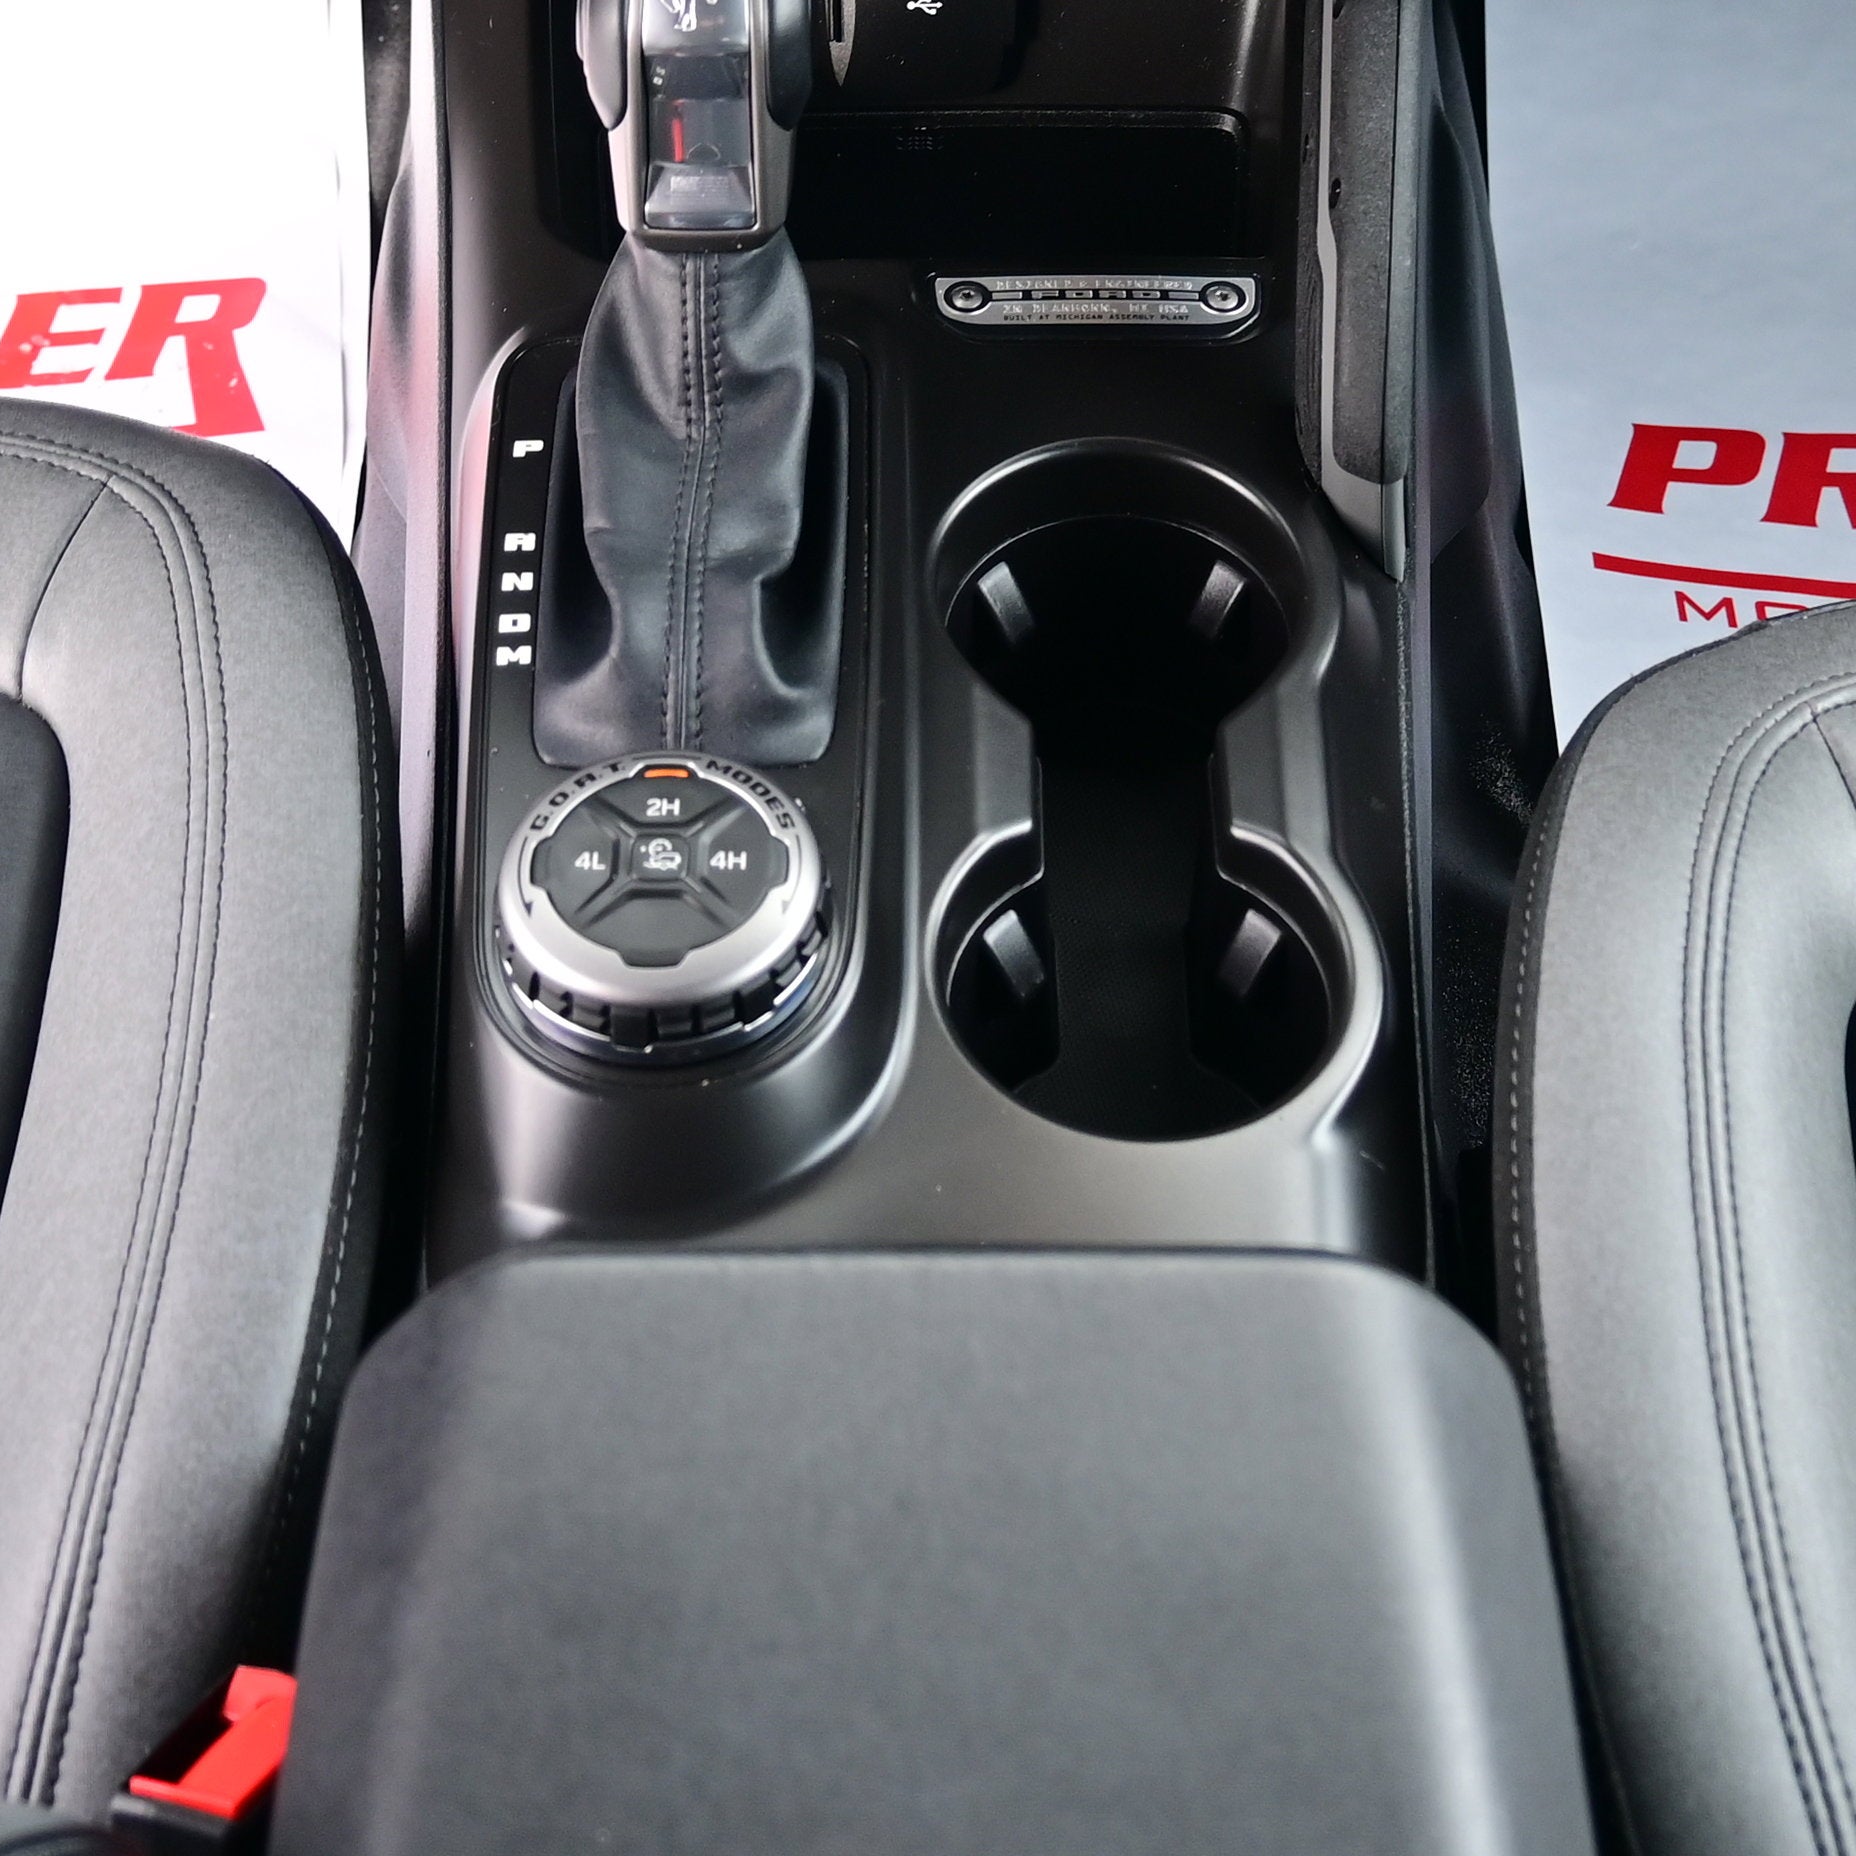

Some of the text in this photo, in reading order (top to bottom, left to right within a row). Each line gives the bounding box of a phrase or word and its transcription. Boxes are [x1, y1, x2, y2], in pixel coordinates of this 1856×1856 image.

[1031, 290, 1161, 300] FORD
[1004, 314, 1032, 322] BUILT
[1161, 314, 1190, 322] PLANT
[1159, 304, 1189, 314] USA
[512, 439, 545, 458] P
[504, 532, 536, 552] R
[500, 572, 533, 592] N
[497, 613, 532, 634] D
[495, 645, 532, 666] M
[706, 760, 796, 830] MODES
[646, 797, 681, 817] 2H
[574, 851, 606, 871] 4L
[709, 850, 748, 871] 4H
